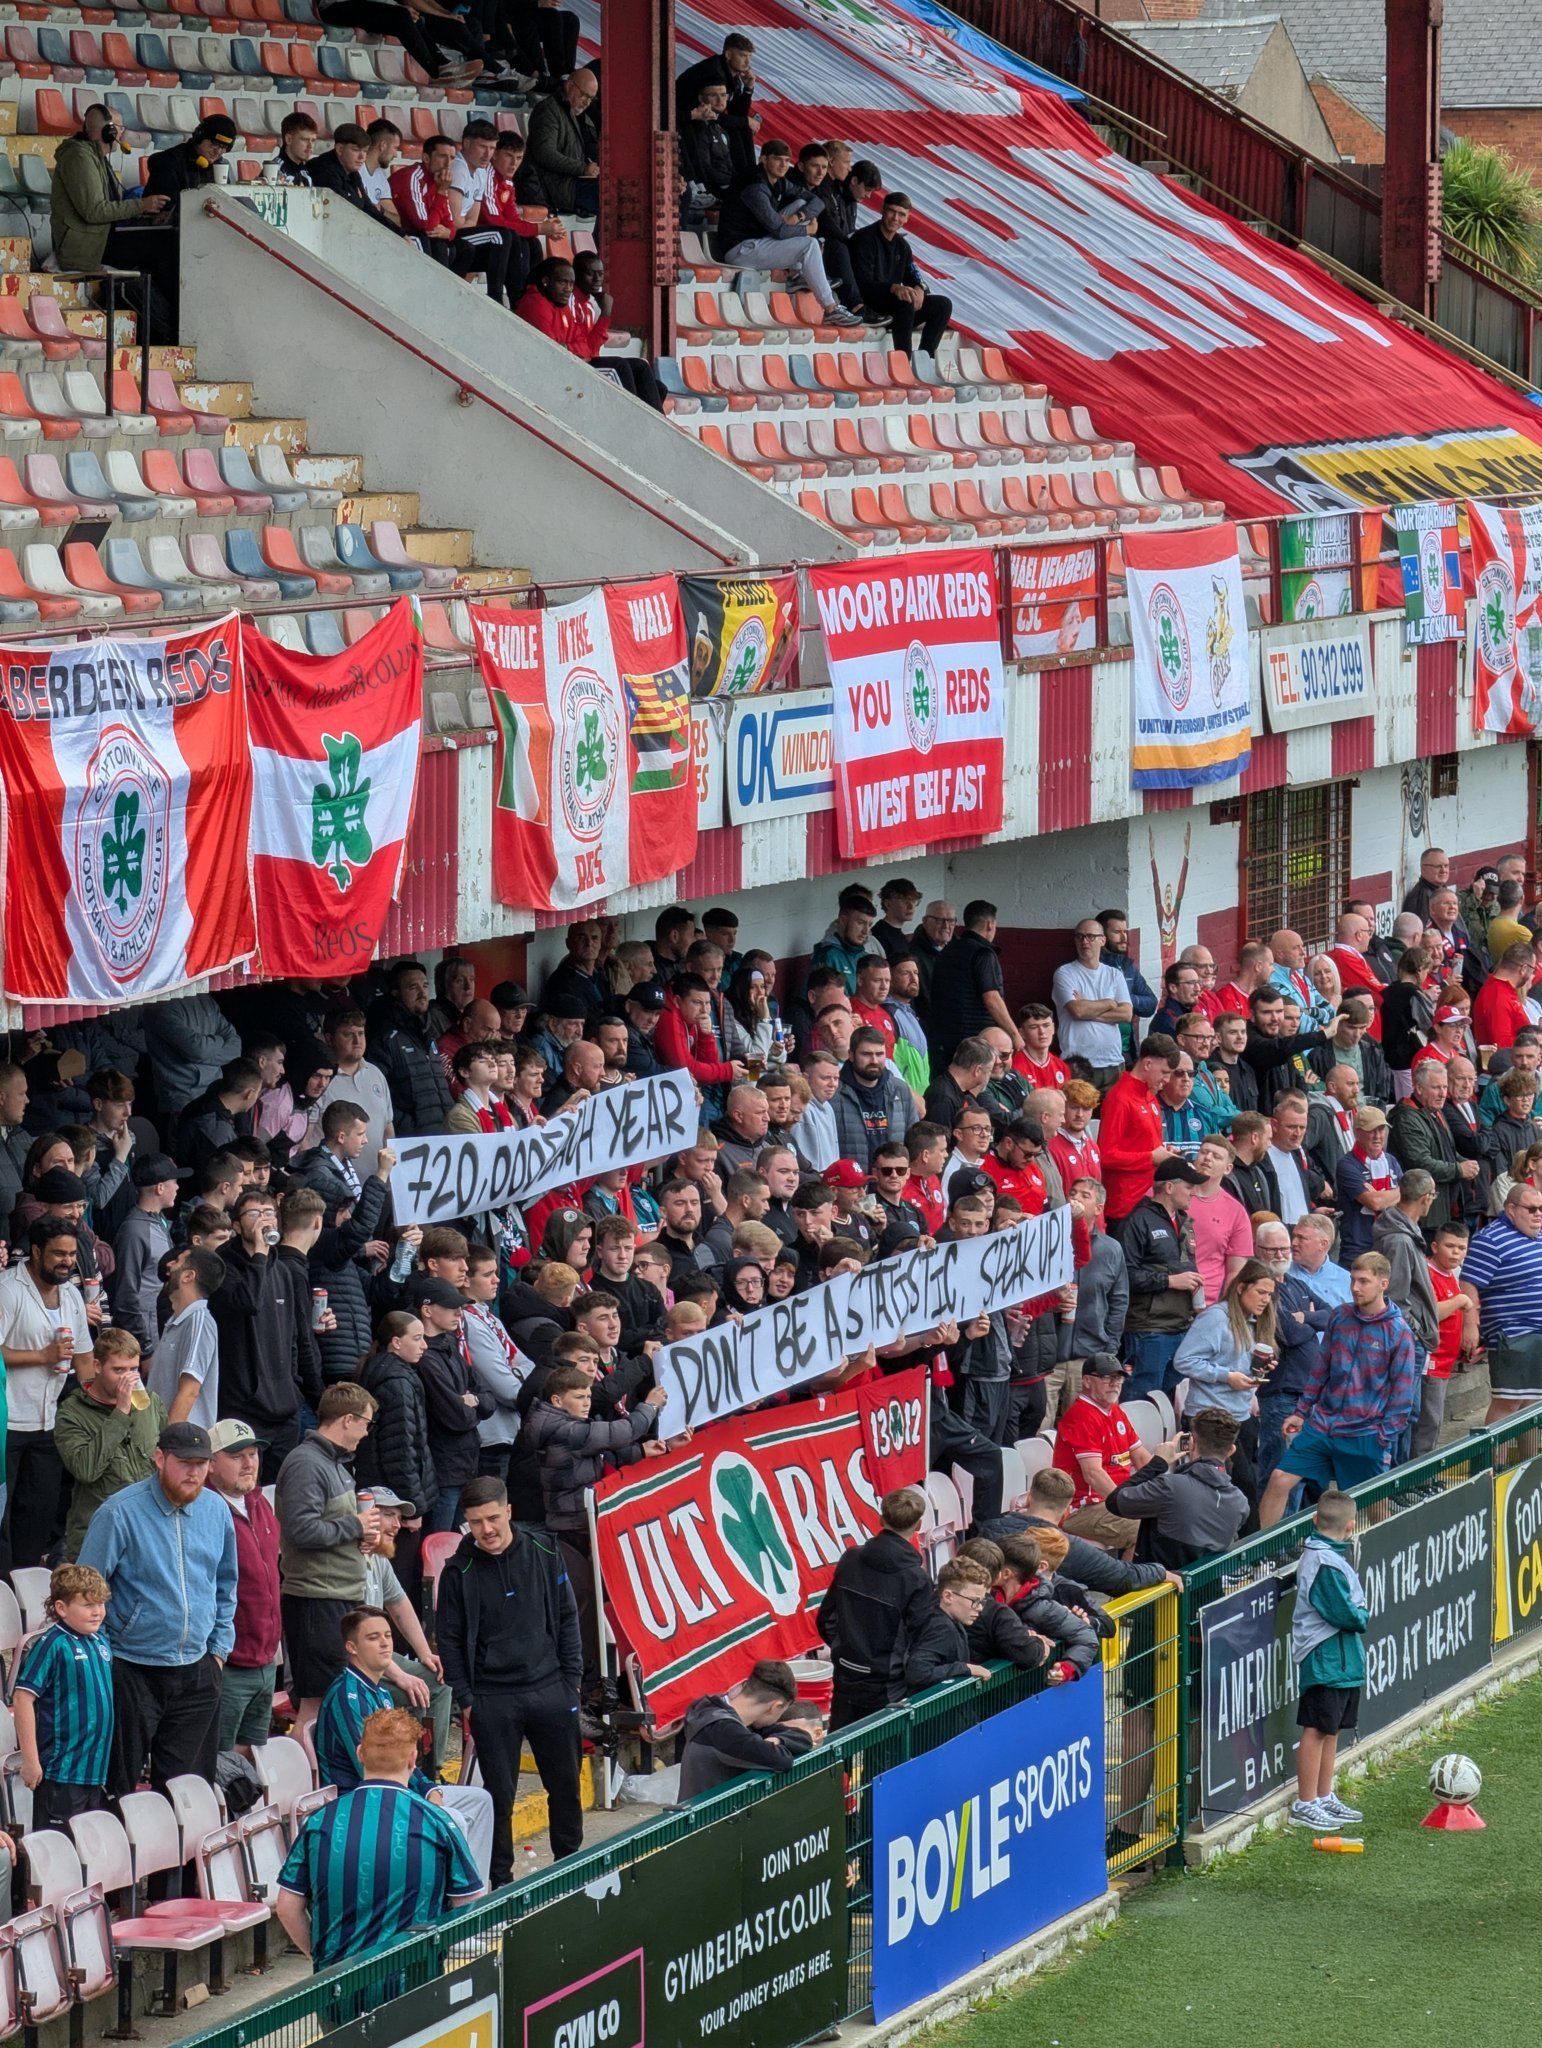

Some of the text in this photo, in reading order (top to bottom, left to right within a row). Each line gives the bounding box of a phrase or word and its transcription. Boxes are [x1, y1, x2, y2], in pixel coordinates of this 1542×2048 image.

[996, 548, 1094, 589] HAEL NEWBER
[628, 592, 673, 642] WALL
[816, 571, 992, 636] MOOR PARK REDS
[502, 625, 539, 669] HOLE
[557, 611, 594, 665] IN THE
[147, 639, 233, 708] REDS
[848, 680, 892, 732] YOU
[946, 667, 991, 715] REDS
[1269, 640, 1364, 706] TEL: 90 312 999
[565, 750, 578, 824] FOOTBALL
[738, 711, 778, 806] OK
[856, 782, 911, 833] WEST
[82, 826, 163, 962] FOOTBALL & ATHLETIC CLUB
[1376, 907, 1395, 937] 1961
[401, 1137, 547, 1217] 720,000
[606, 1079, 686, 1158] YEAR
[670, 1317, 761, 1426] DON'T
[773, 1297, 818, 1378] BE
[824, 1285, 844, 1361] A
[980, 1224, 1034, 1307] SPEAK
[1037, 1209, 1066, 1283] UP!
[1515, 1480, 1542, 1556] fon
[1364, 1507, 1488, 1619] ON THE OUTSIDE
[1250, 1590, 1274, 1618] THE
[1365, 1588, 1477, 1700] RED AT HEART
[1217, 1633, 1300, 1742] AMERICA
[1244, 1743, 1285, 1792] BAR
[761, 1826, 831, 1883] JOIN TODAY
[888, 1735, 1092, 1947] BOYLE SPORTS
[664, 1878, 833, 2003] GYMBELFAST.CO.UK
[554, 1999, 620, 2048] GYM CO
[700, 2004, 726, 2038] YOUR
[772, 1963, 805, 1998] STARTS
[808, 1949, 833, 1979] HERE.
